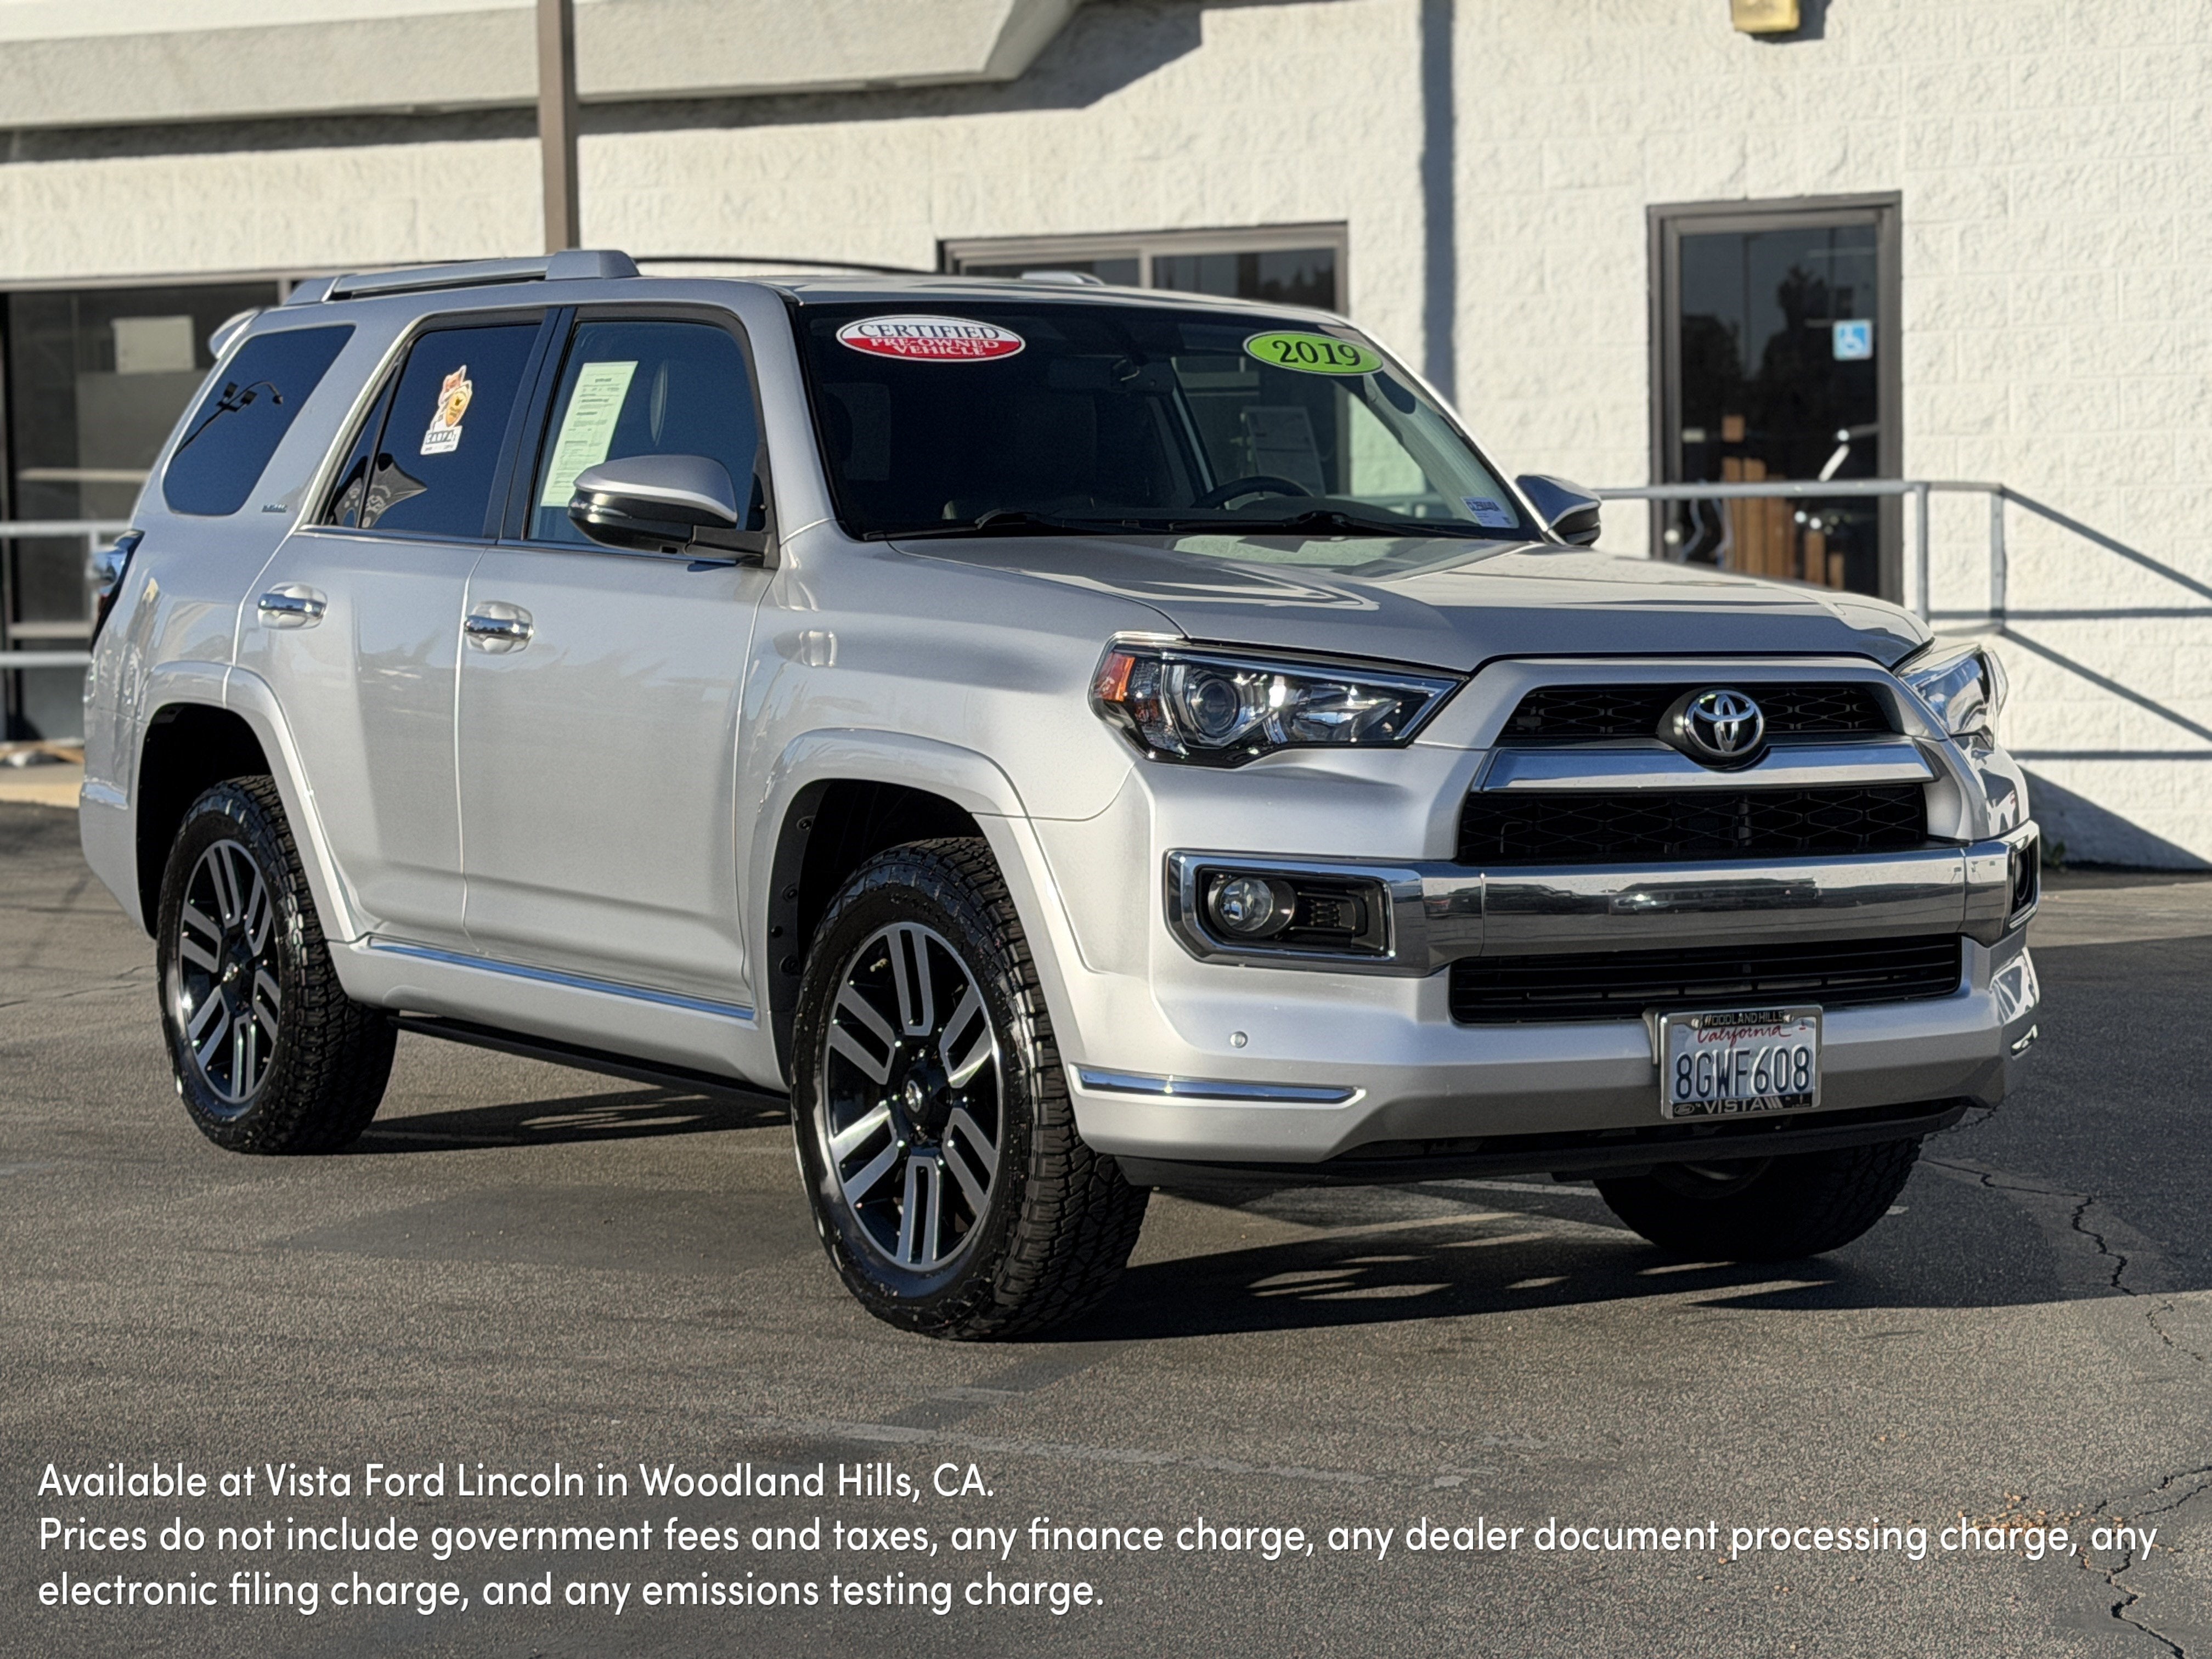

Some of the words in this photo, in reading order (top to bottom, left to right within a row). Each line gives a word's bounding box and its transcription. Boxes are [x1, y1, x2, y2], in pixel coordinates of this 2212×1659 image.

[857, 324, 1000, 340] CERTIFIED
[870, 338, 999, 348] PRE-OWNED
[893, 346, 986, 356] VEHICLE
[1271, 340, 1361, 366] 2019
[1697, 1024, 1792, 1048] California
[1675, 1044, 1809, 1099] 8GWF608
[1703, 1097, 1765, 1114] VISTA
